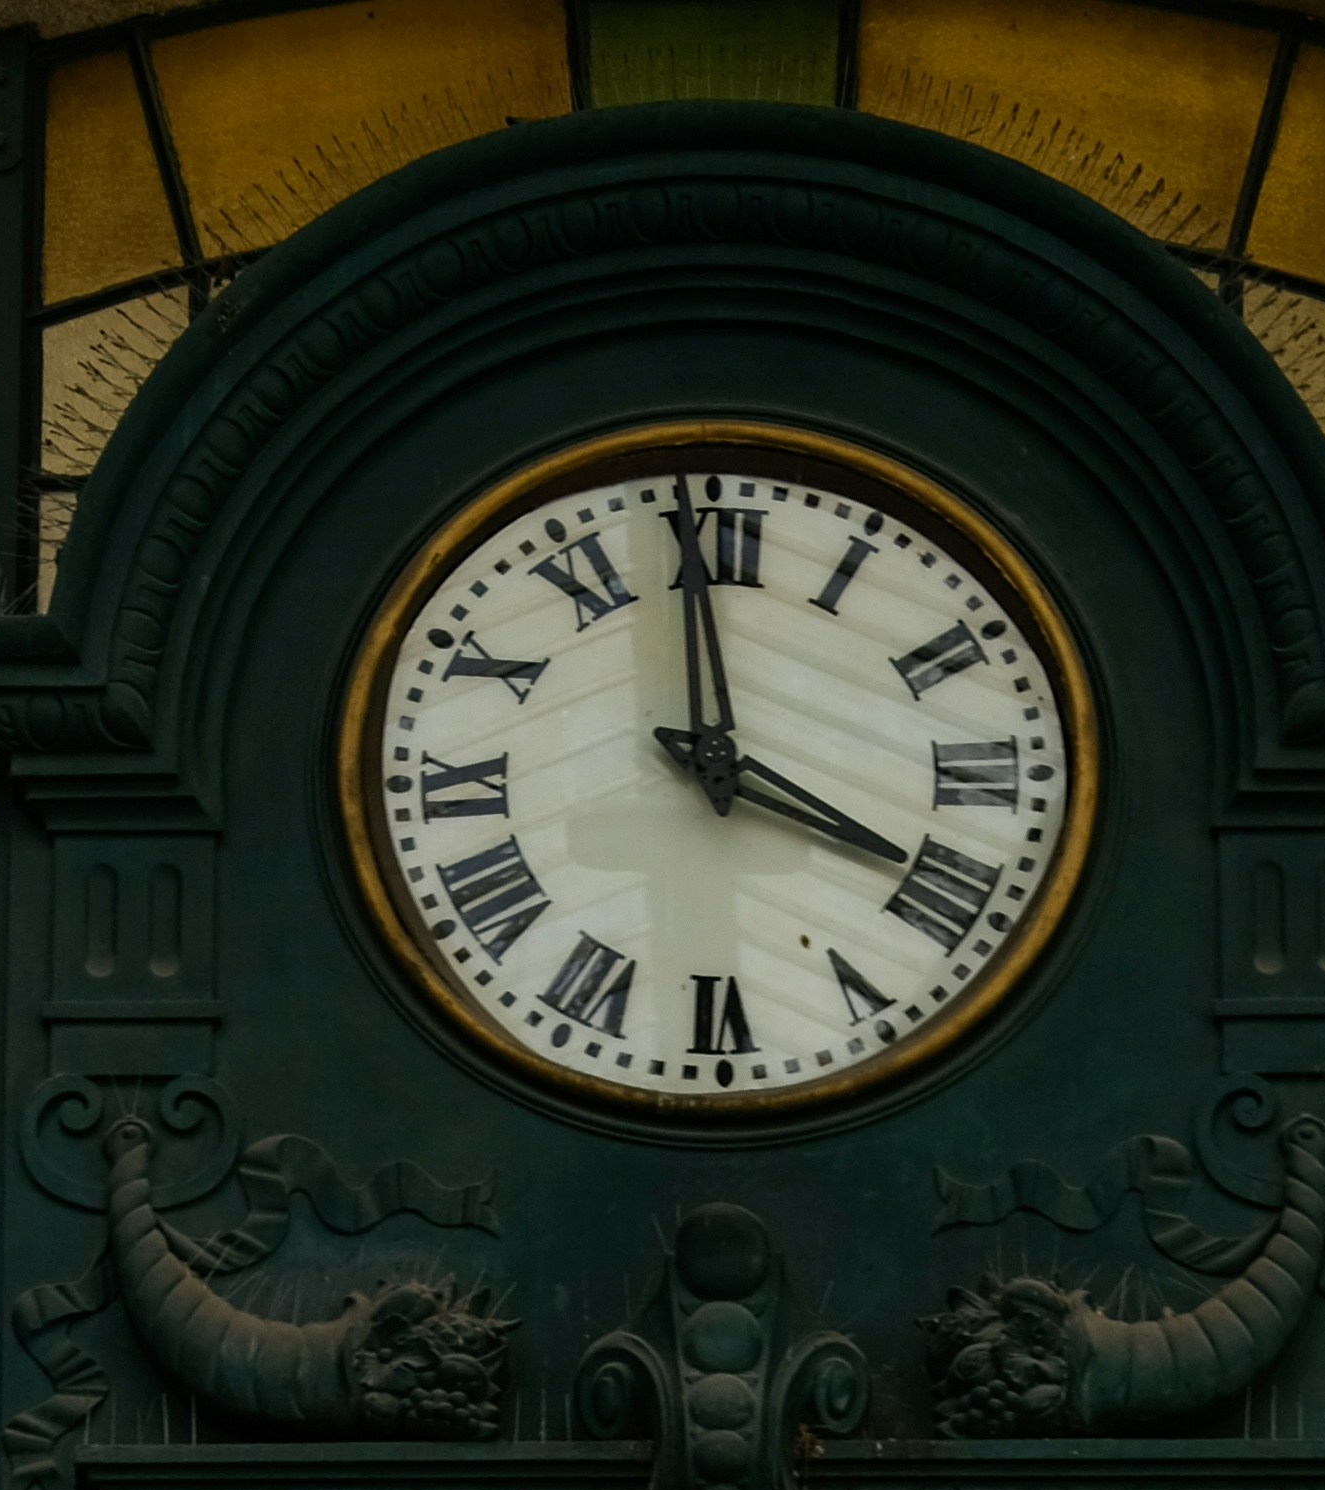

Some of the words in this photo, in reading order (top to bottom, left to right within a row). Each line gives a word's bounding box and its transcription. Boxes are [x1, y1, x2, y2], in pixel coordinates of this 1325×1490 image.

[529, 532, 638, 632] XI
[808, 535, 878, 615] I
[444, 631, 550, 704] X
[890, 620, 988, 701] II
[421, 751, 510, 824] IX
[932, 735, 1020, 812] III
[437, 835, 551, 964] VIII
[537, 930, 637, 1039] VII
[688, 975, 759, 1055] VI
[828, 948, 897, 1026] V
